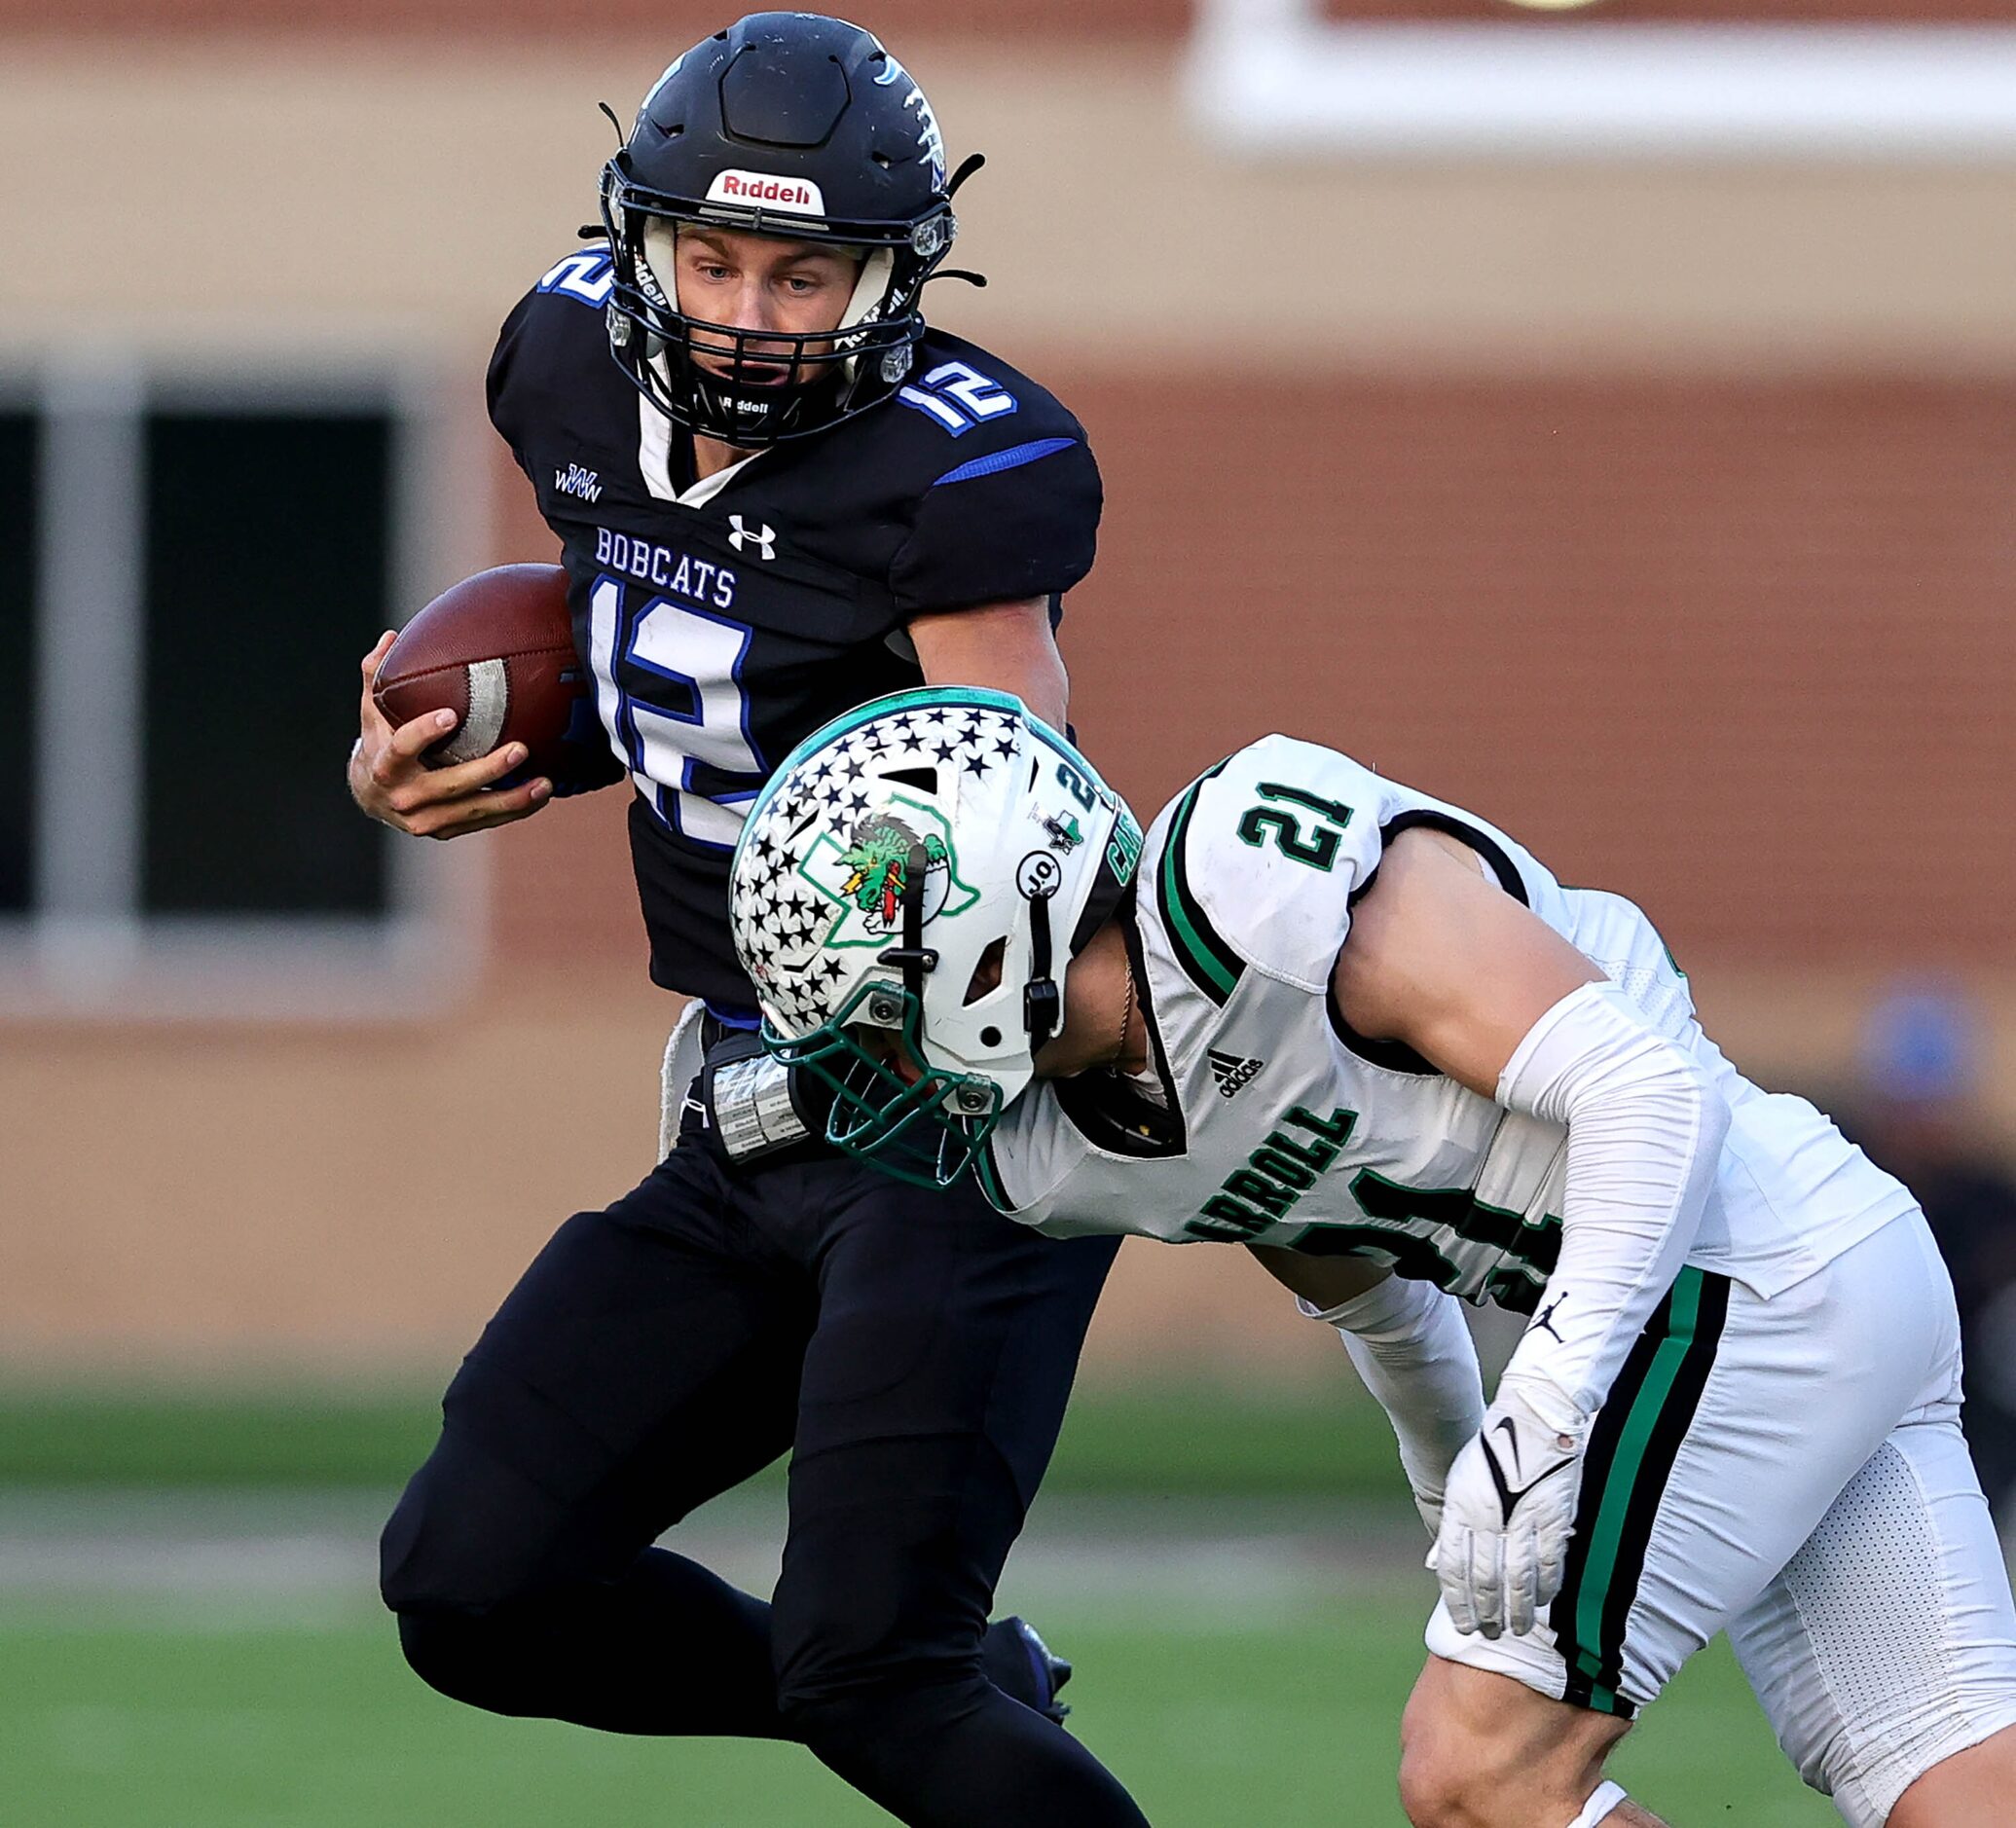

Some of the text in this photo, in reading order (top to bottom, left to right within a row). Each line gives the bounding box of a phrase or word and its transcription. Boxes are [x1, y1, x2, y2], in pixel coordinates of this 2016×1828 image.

[723, 175, 810, 204] Riddell
[536, 240, 614, 310] 2
[723, 396, 769, 414] Rddell
[896, 360, 1017, 438] 12
[595, 527, 736, 608] BOBCATS
[588, 572, 770, 851] 12
[1236, 782, 1354, 872] 21
[1220, 1058, 1264, 1098] adidas
